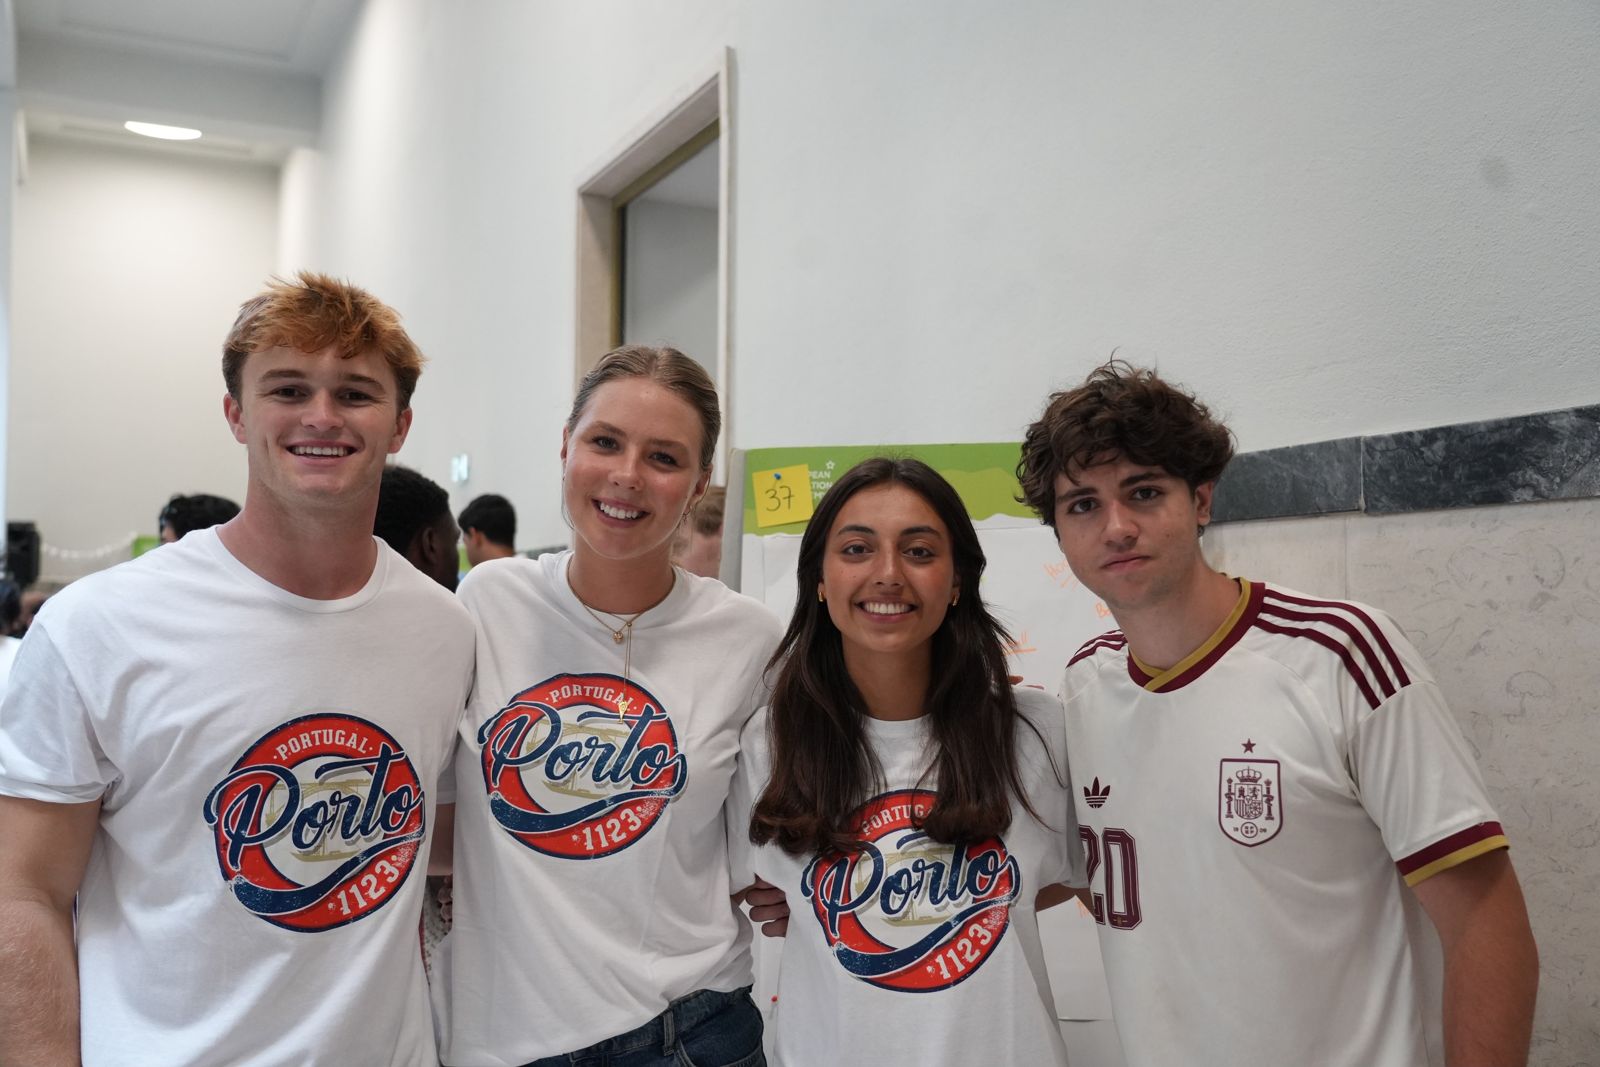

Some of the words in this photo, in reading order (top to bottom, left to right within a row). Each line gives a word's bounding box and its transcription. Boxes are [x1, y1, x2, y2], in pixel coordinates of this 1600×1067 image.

[764, 485, 795, 512] 37
[275, 728, 370, 761] PORTUGAL
[477, 701, 688, 788] Porto
[203, 741, 425, 872] Porto
[583, 808, 642, 851] 1123
[861, 804, 934, 837] PORTUG
[337, 860, 400, 916] 1123
[801, 832, 1021, 938] Porto
[935, 924, 992, 980] 1123
